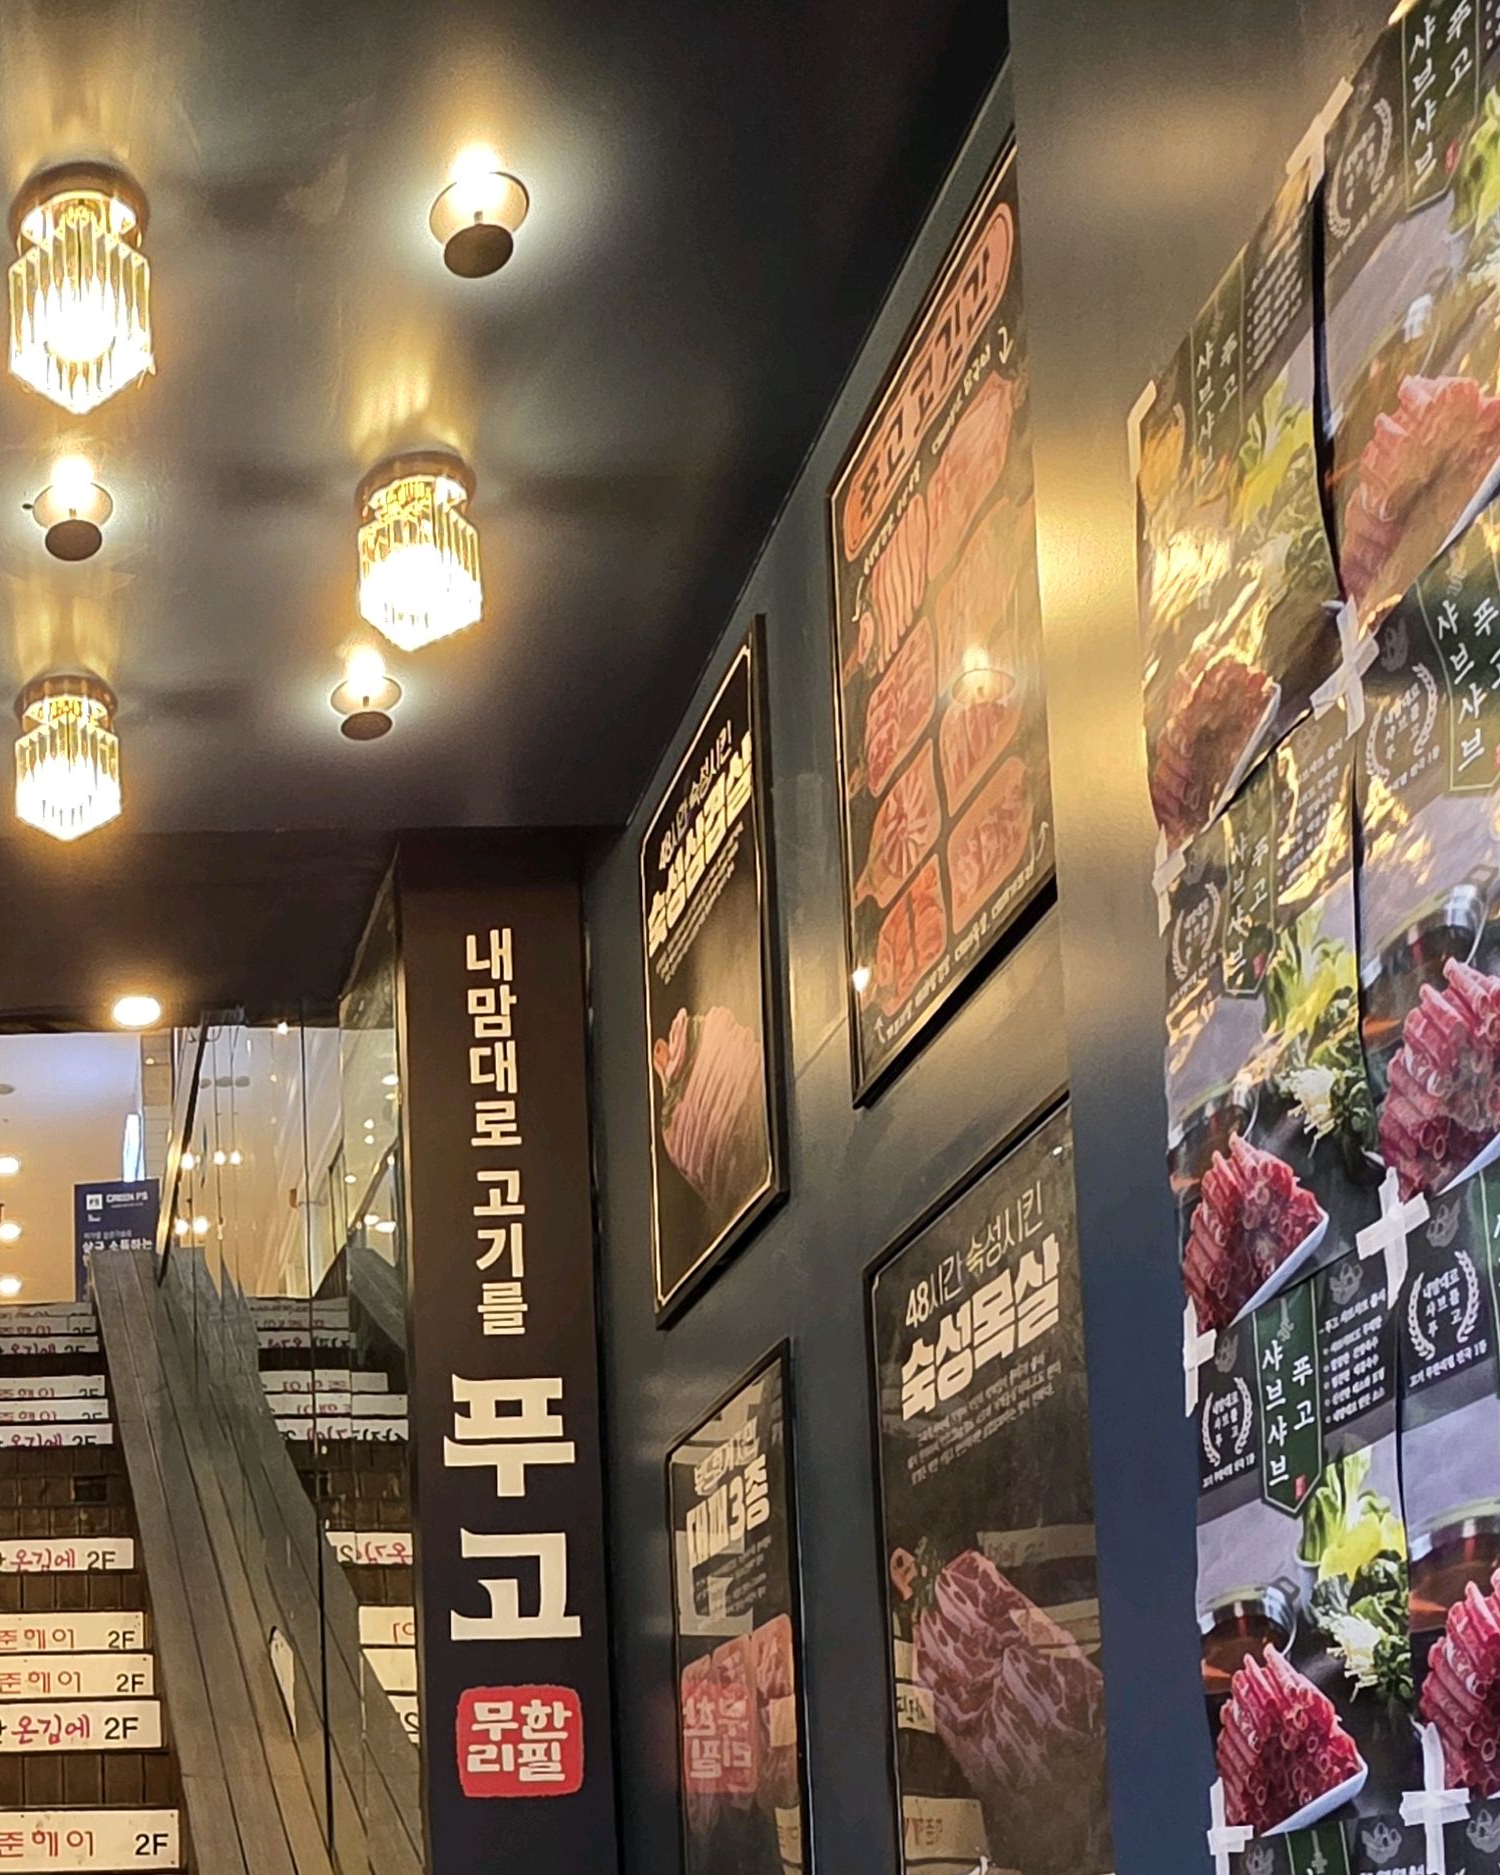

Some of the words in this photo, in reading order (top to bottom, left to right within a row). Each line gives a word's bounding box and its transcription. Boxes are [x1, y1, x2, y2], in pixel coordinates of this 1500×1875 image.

[465, 927, 522, 1147] 내맘대로
[473, 1169, 529, 1336] 고기를
[904, 1251, 965, 1329] 48시간
[966, 1180, 1044, 1274] 숙성시킨
[901, 1232, 1061, 1422] 숙성목살
[1261, 1339, 1289, 1487] 샤브샤브
[1291, 1354, 1315, 1431] 푸고
[443, 1372, 582, 1641] 푸고
[10, 1548, 76, 1572] 온김에
[86, 1551, 117, 1569] 2F
[107, 1630, 136, 1650] 2F
[115, 1673, 146, 1693] 2F
[10, 1713, 92, 1745] 온김에
[103, 1716, 140, 1741] 2F
[470, 1698, 572, 1742] 무한
[466, 1741, 567, 1783] 리필
[134, 1833, 170, 1856] 2F
